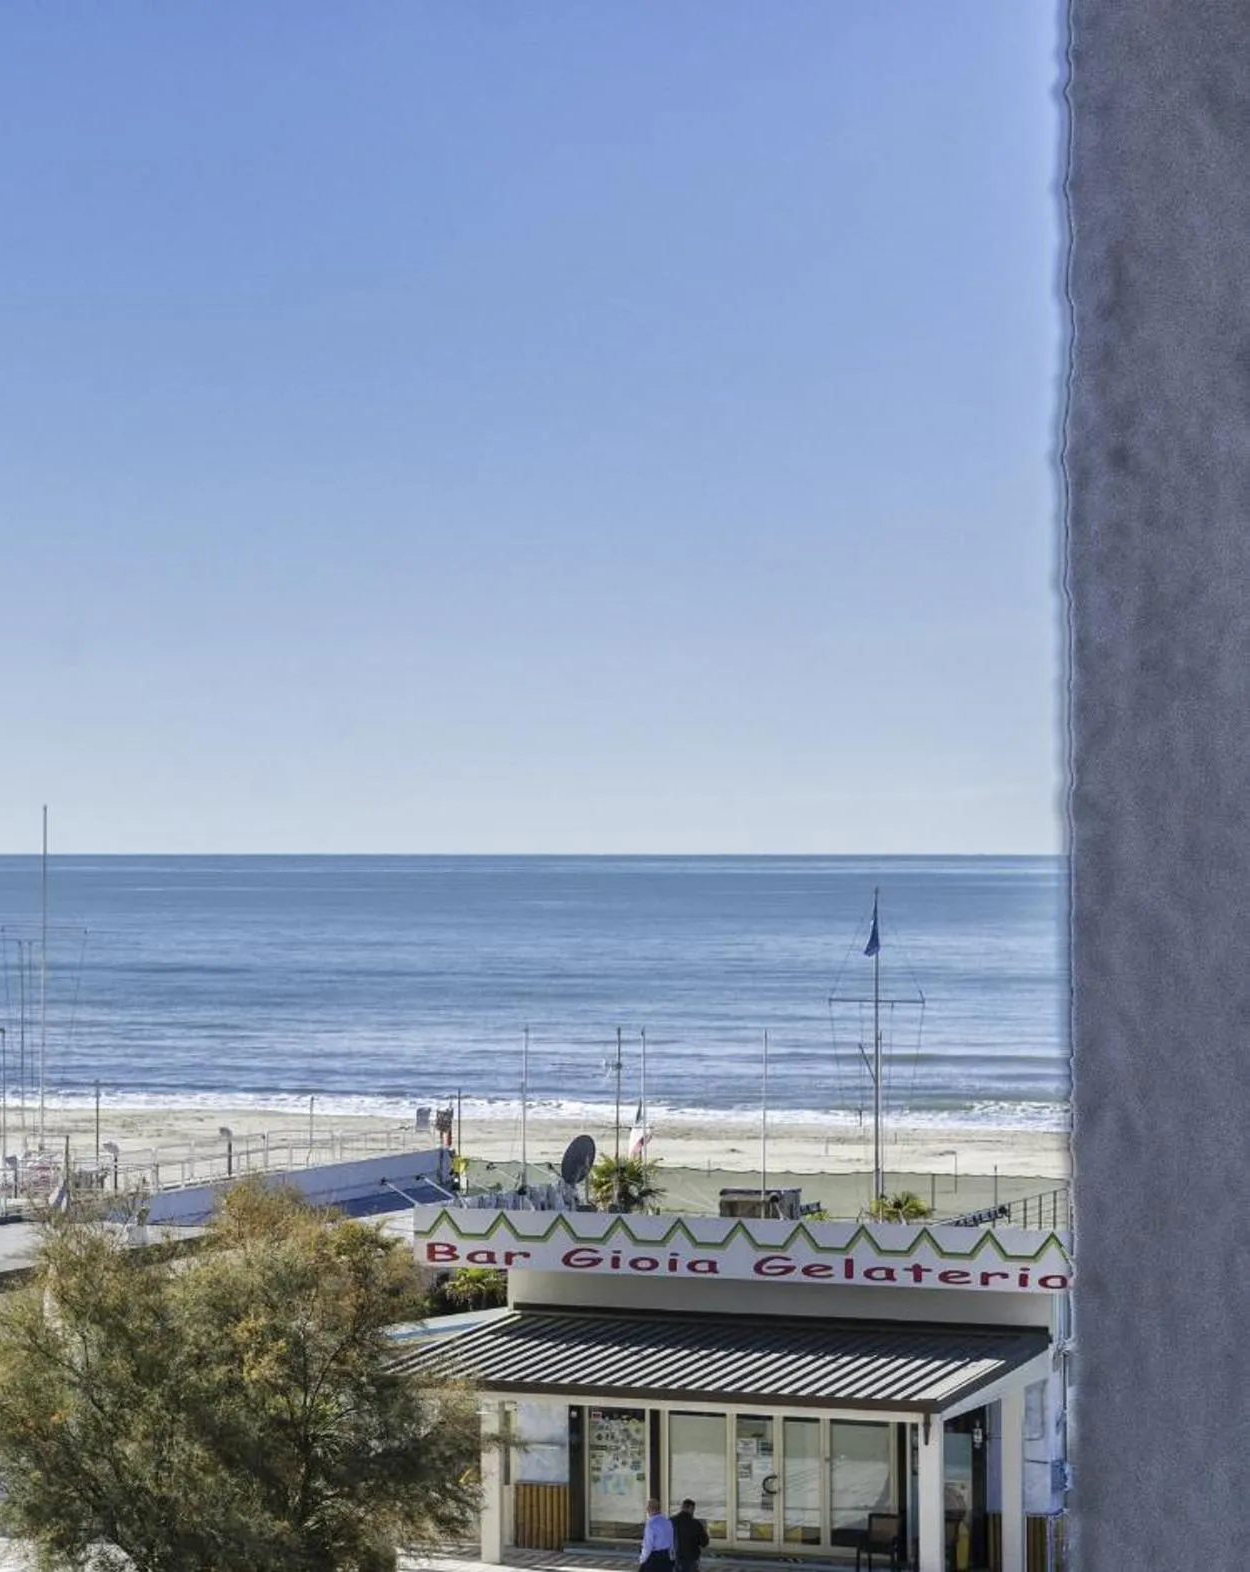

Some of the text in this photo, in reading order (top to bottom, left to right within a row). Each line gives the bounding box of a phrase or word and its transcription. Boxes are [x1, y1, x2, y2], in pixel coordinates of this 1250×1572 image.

[426, 1242, 1068, 1290] Bar Gioia Gelateria
